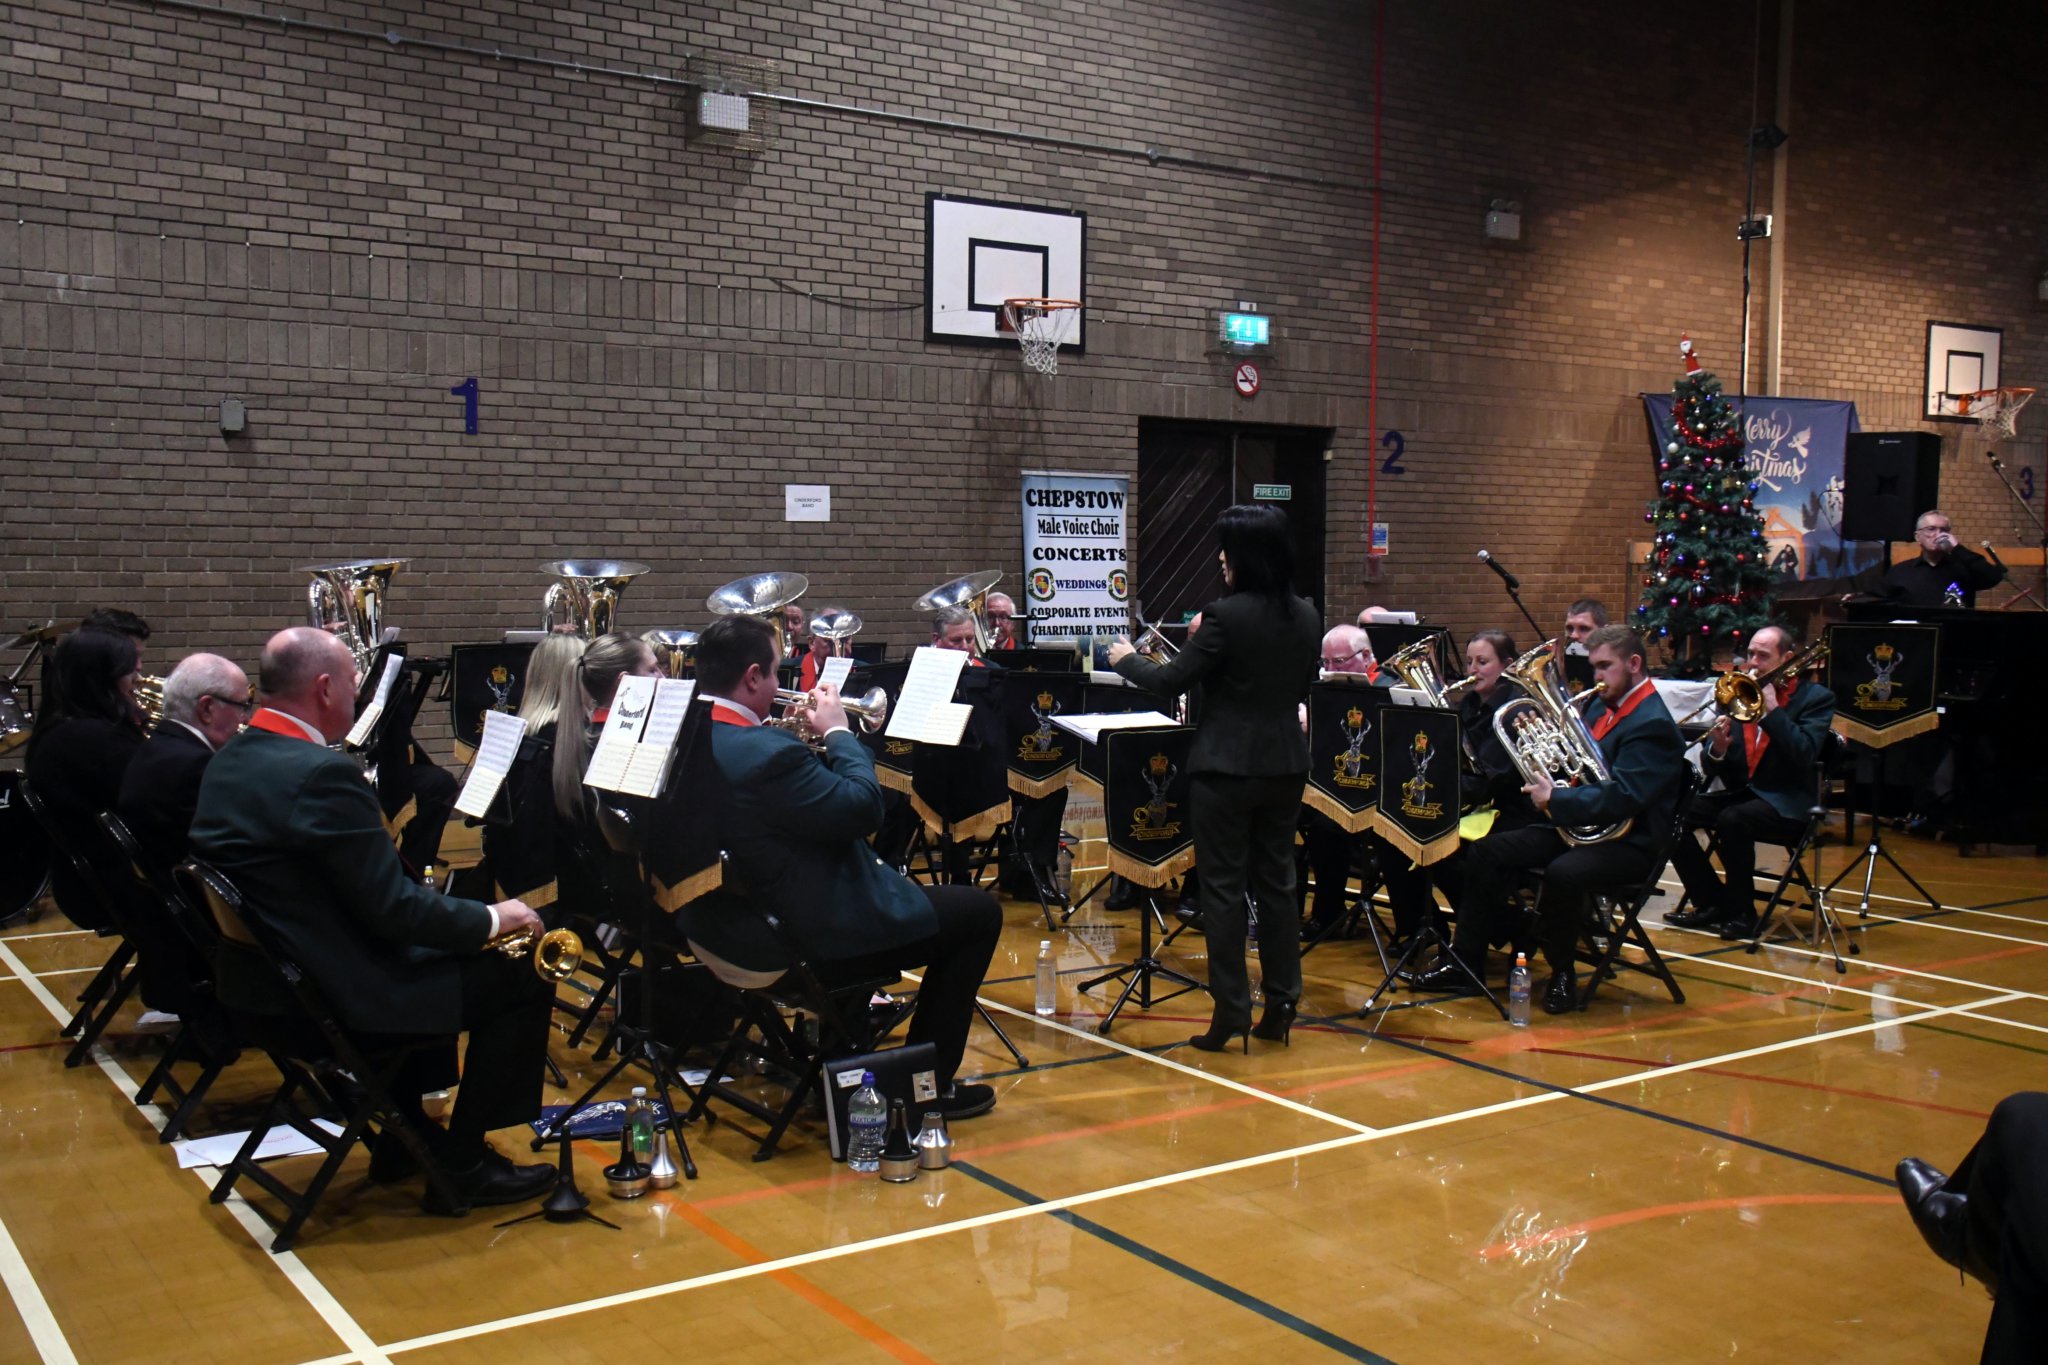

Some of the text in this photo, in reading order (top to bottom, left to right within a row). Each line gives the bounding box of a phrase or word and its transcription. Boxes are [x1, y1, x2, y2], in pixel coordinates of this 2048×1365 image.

[450, 376, 479, 435] 1
[1382, 430, 1406, 475] 2
[1255, 487, 1290, 497] FIRE EXIT
[2019, 466, 2035, 500] 3
[1025, 488, 1125, 509] CHEPSTOW
[1037, 517, 1120, 536] Male Voice Choir
[1033, 547, 1127, 561] CONCERTS
[1055, 579, 1107, 590] WEDDINGS
[1032, 625, 1093, 636] CHARITABLE
